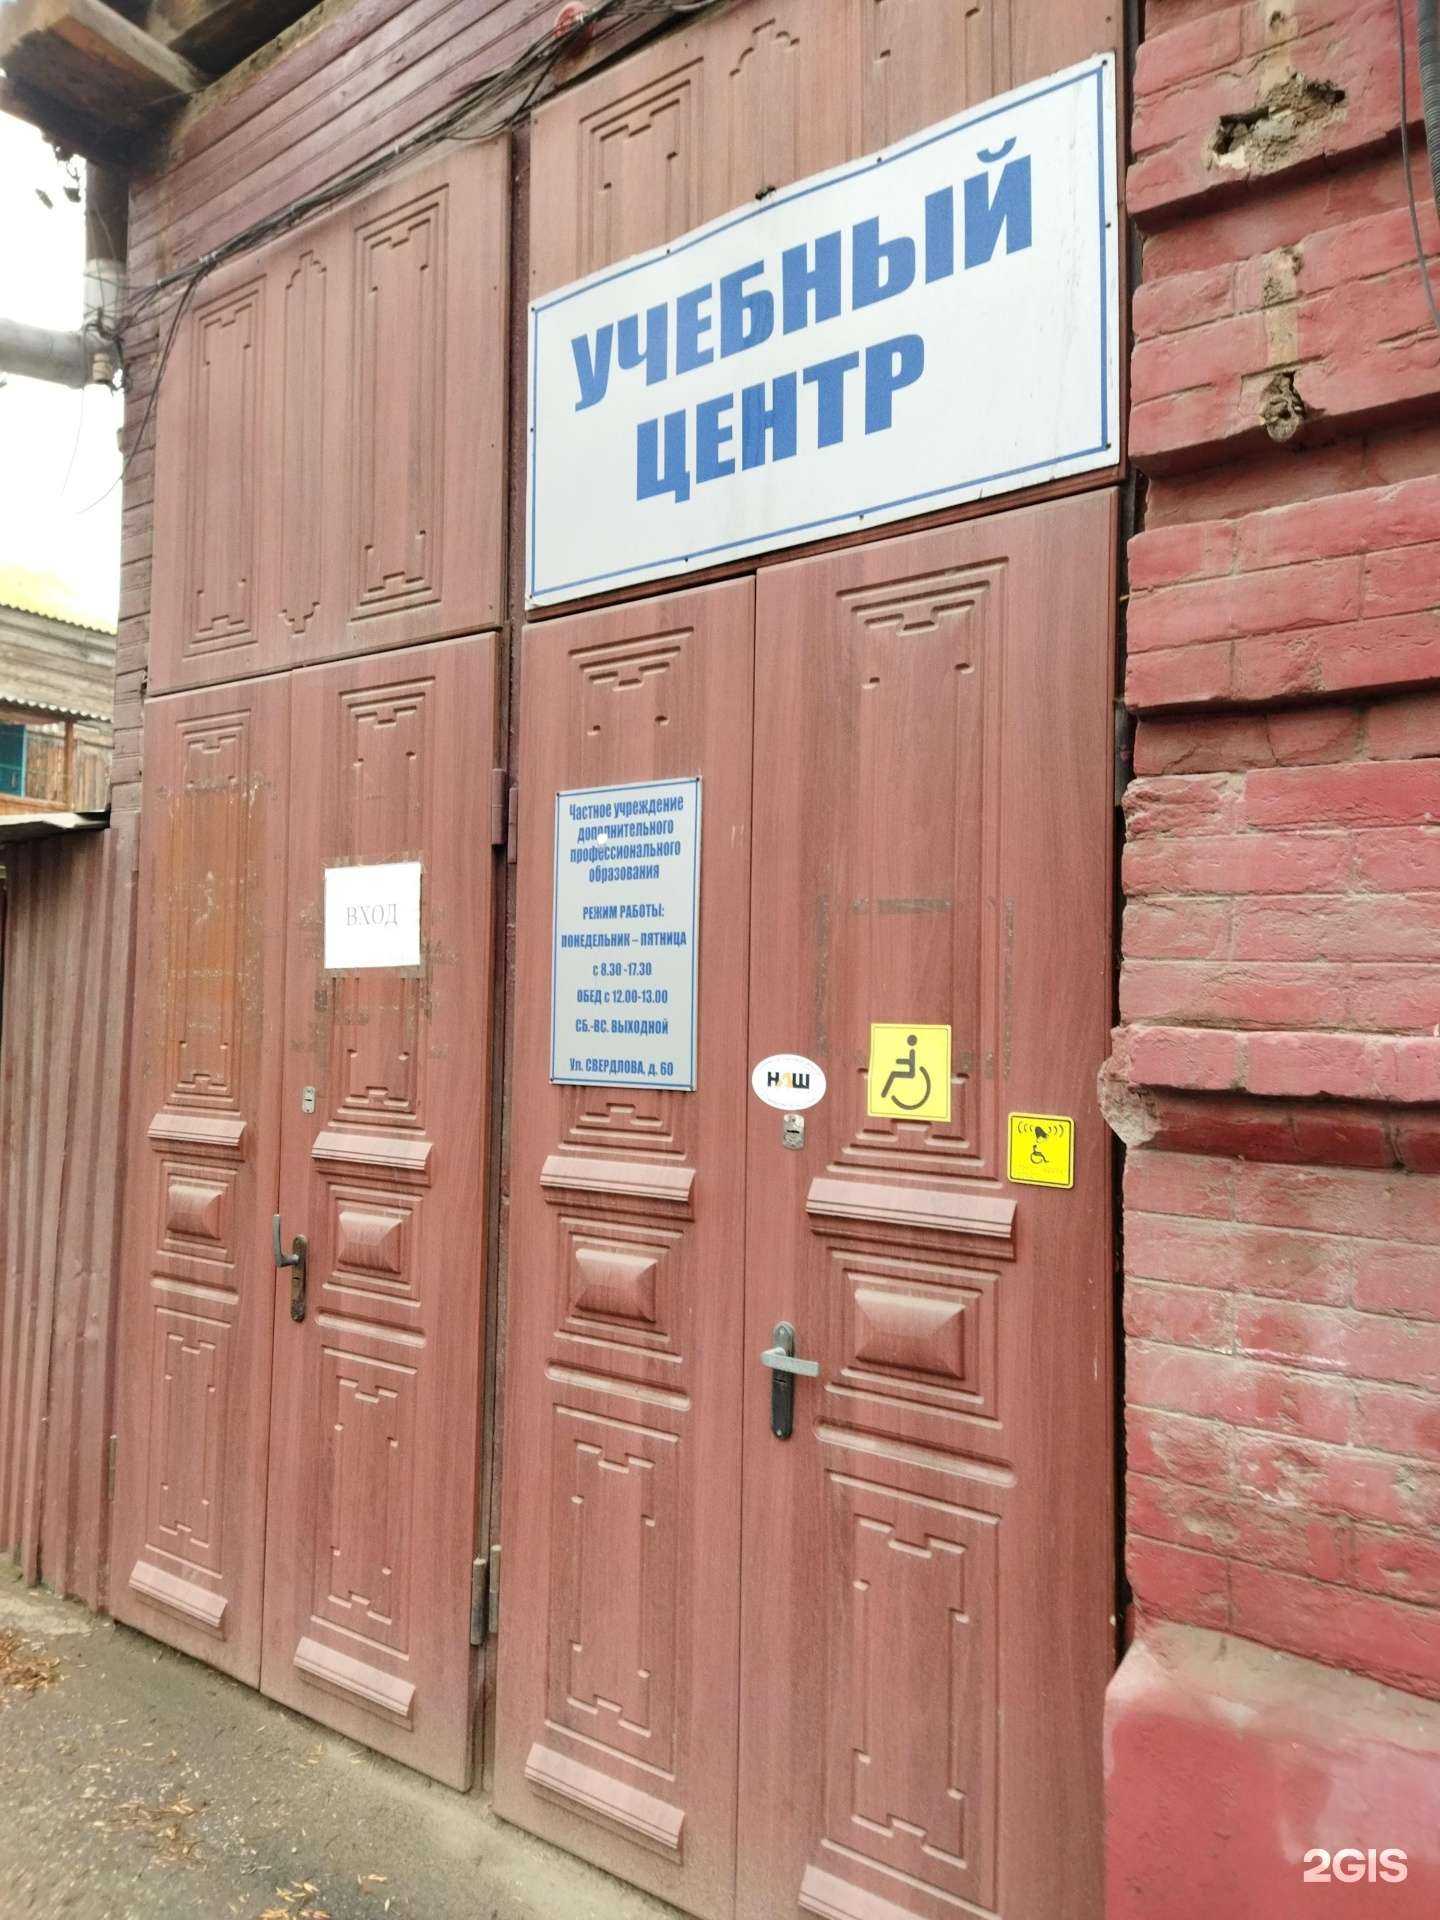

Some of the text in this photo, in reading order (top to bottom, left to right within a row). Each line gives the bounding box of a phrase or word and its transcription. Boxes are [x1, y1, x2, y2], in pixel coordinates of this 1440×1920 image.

[571, 136, 1032, 412] УЧЕБНЫЙ
[636, 334, 925, 504] ЦЕНТР
[569, 796, 684, 820] Частное учреждение
[570, 840, 681, 864] профессионального
[589, 864, 660, 883] образования
[346, 904, 398, 926] ВХОД
[583, 903, 665, 920] РЕЖИМ РАБОТЫ:
[561, 933, 630, 949] ПОНЕДЕЛЬНИК
[640, 931, 687, 947] ПЯТНИЦА
[577, 989, 602, 1004] ОБЕД
[612, 989, 668, 1004] 12.00-13.00
[611, 1018, 668, 1036] ВЫХОДНОЙ
[660, 1061, 674, 1076] 60
